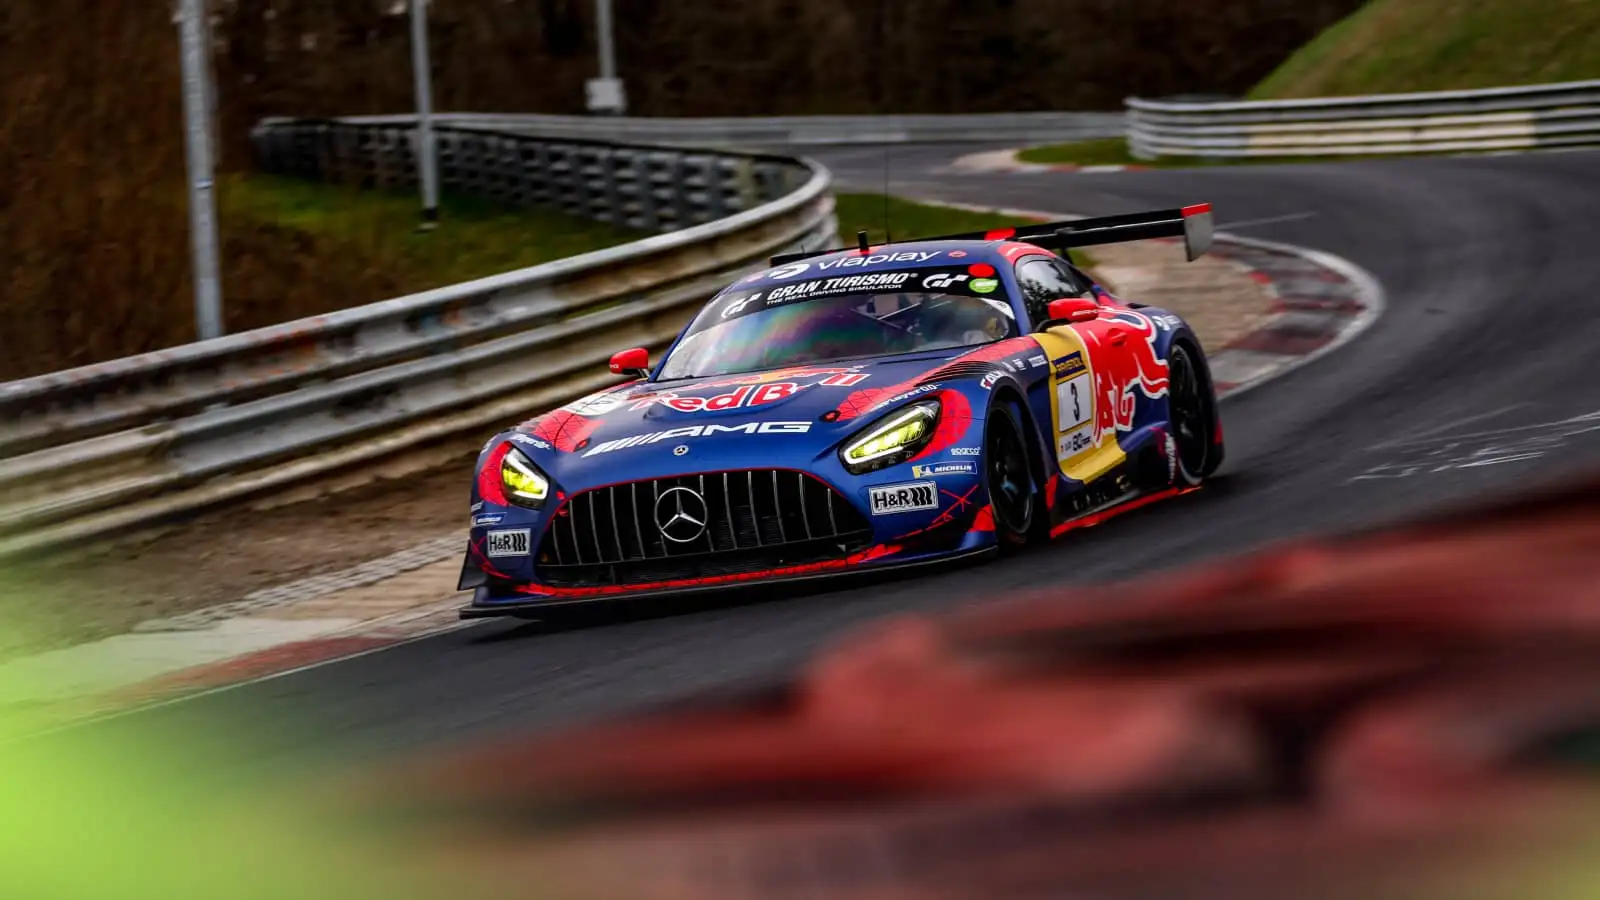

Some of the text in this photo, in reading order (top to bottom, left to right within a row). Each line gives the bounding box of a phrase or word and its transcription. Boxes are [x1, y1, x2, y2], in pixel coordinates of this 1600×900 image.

[818, 251, 942, 270] viaplay
[767, 273, 909, 300] GRAN TURISMO
[785, 293, 808, 302] REAL
[809, 288, 847, 298] DRIVING
[848, 284, 902, 292] SIMULATOR
[1070, 382, 1080, 422] 3
[935, 464, 973, 473] MICHELIN
[872, 488, 914, 510] H&R
[489, 534, 511, 551] H&R
